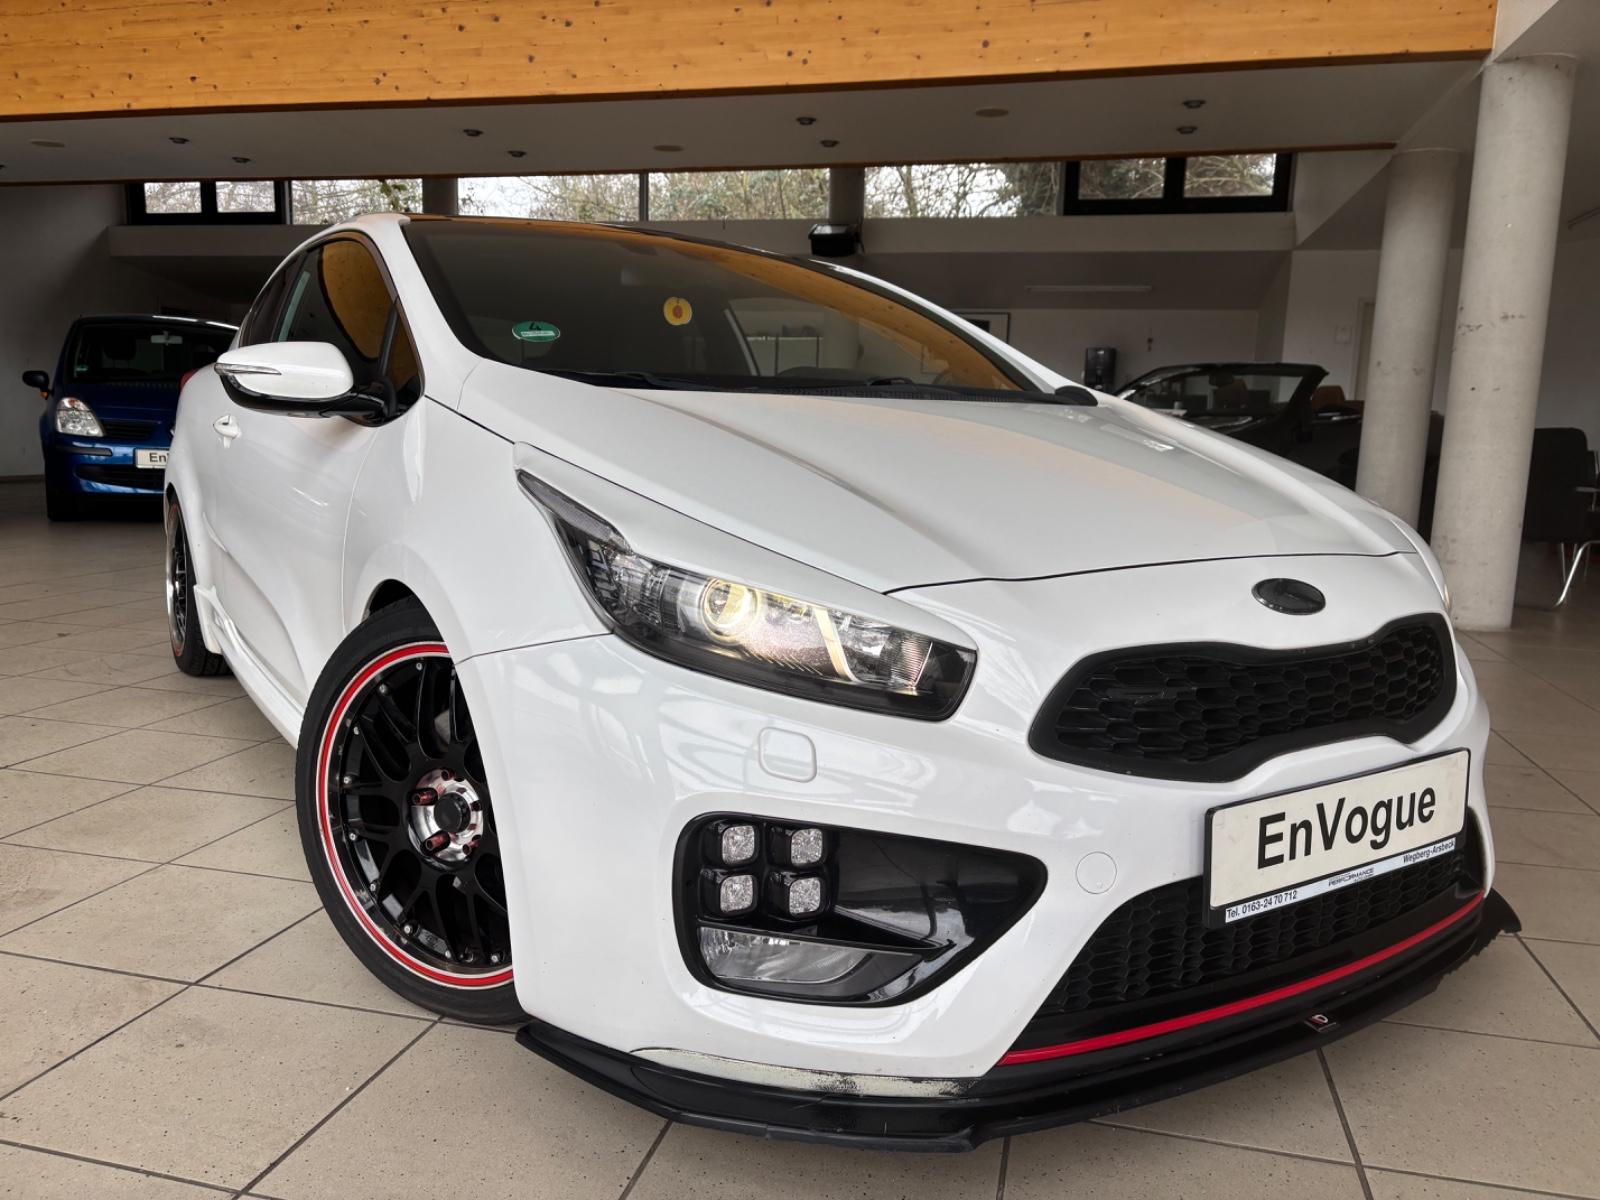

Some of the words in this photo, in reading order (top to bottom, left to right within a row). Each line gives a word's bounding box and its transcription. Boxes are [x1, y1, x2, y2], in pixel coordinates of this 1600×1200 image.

[149, 452, 169, 462] En
[1257, 787, 1436, 869] EnVogue
[1226, 908, 1240, 918] Tel.
